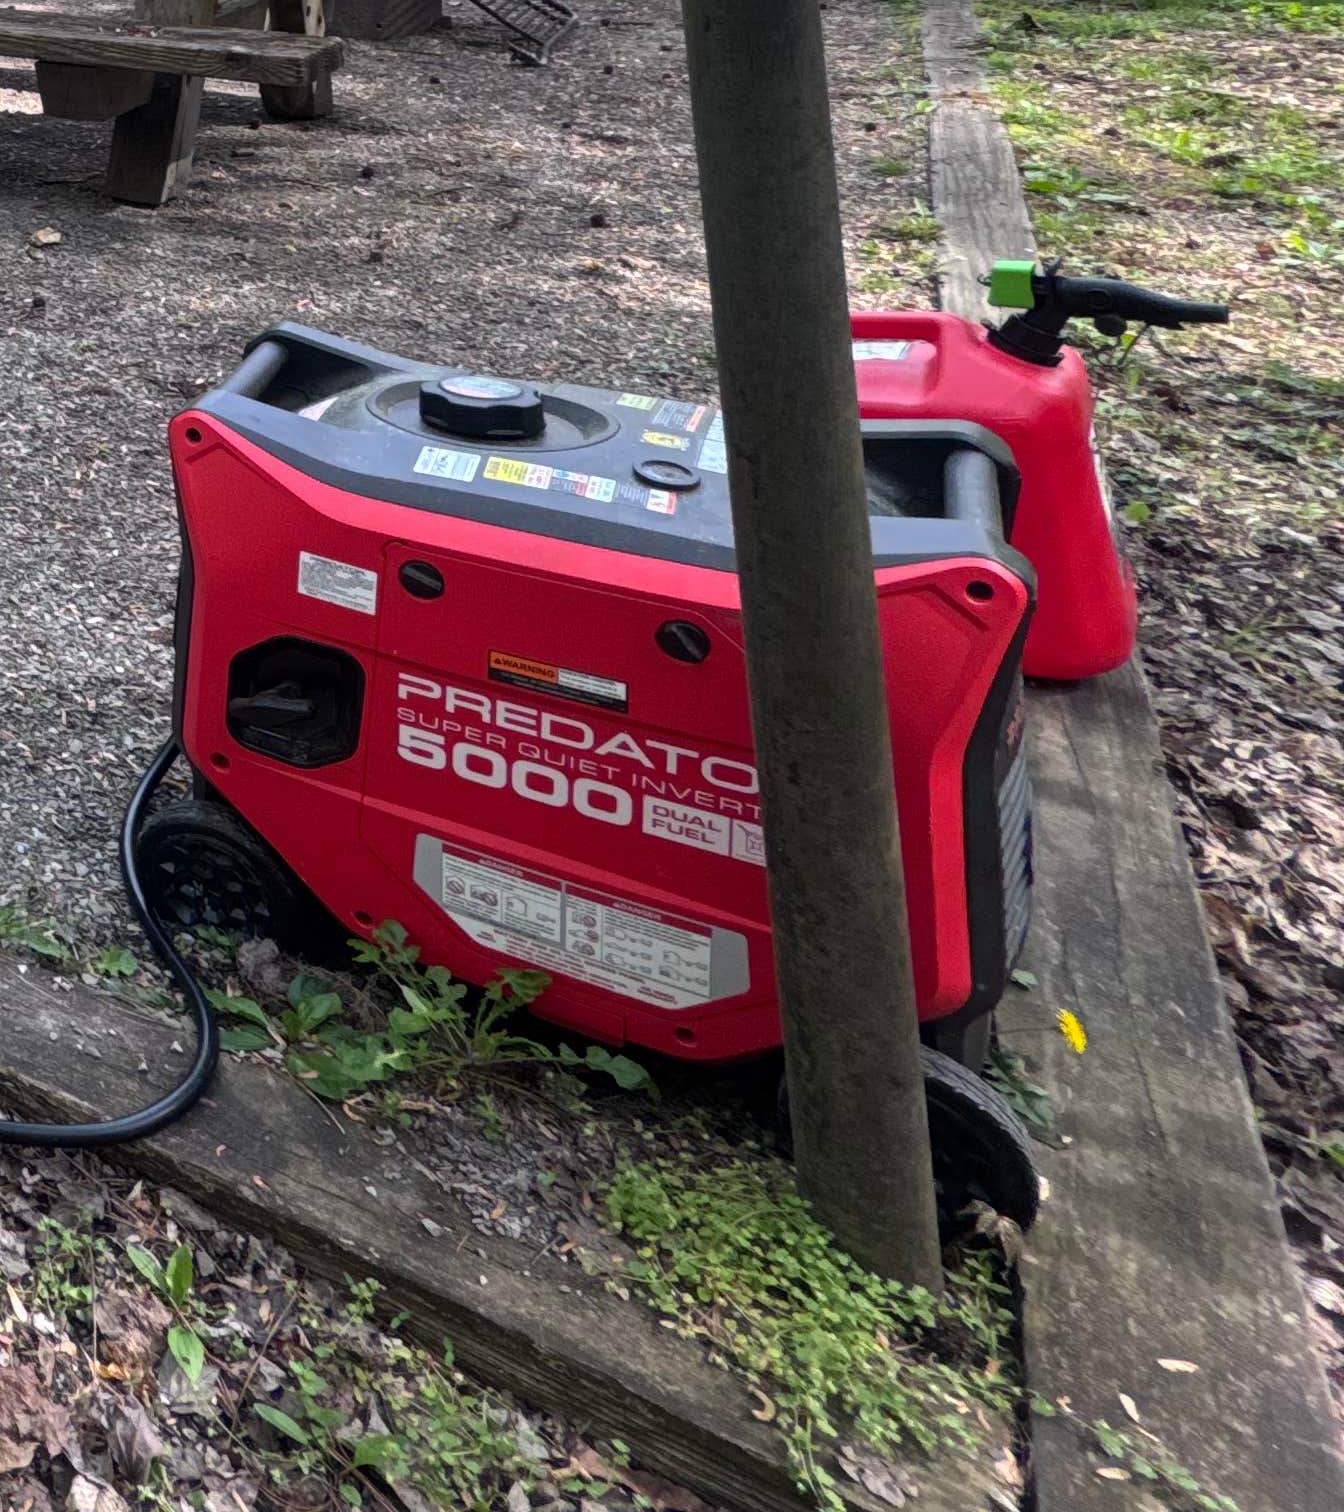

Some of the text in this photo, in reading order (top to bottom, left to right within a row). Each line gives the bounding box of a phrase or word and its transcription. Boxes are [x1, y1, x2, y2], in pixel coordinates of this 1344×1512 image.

[501, 657, 555, 678] WARNING
[397, 672, 761, 795] PREDATO
[397, 706, 763, 820] SUPER QUIET INVERT
[397, 723, 633, 827] 5000
[650, 817, 716, 845] FUEL
[651, 803, 722, 833] DUAL
